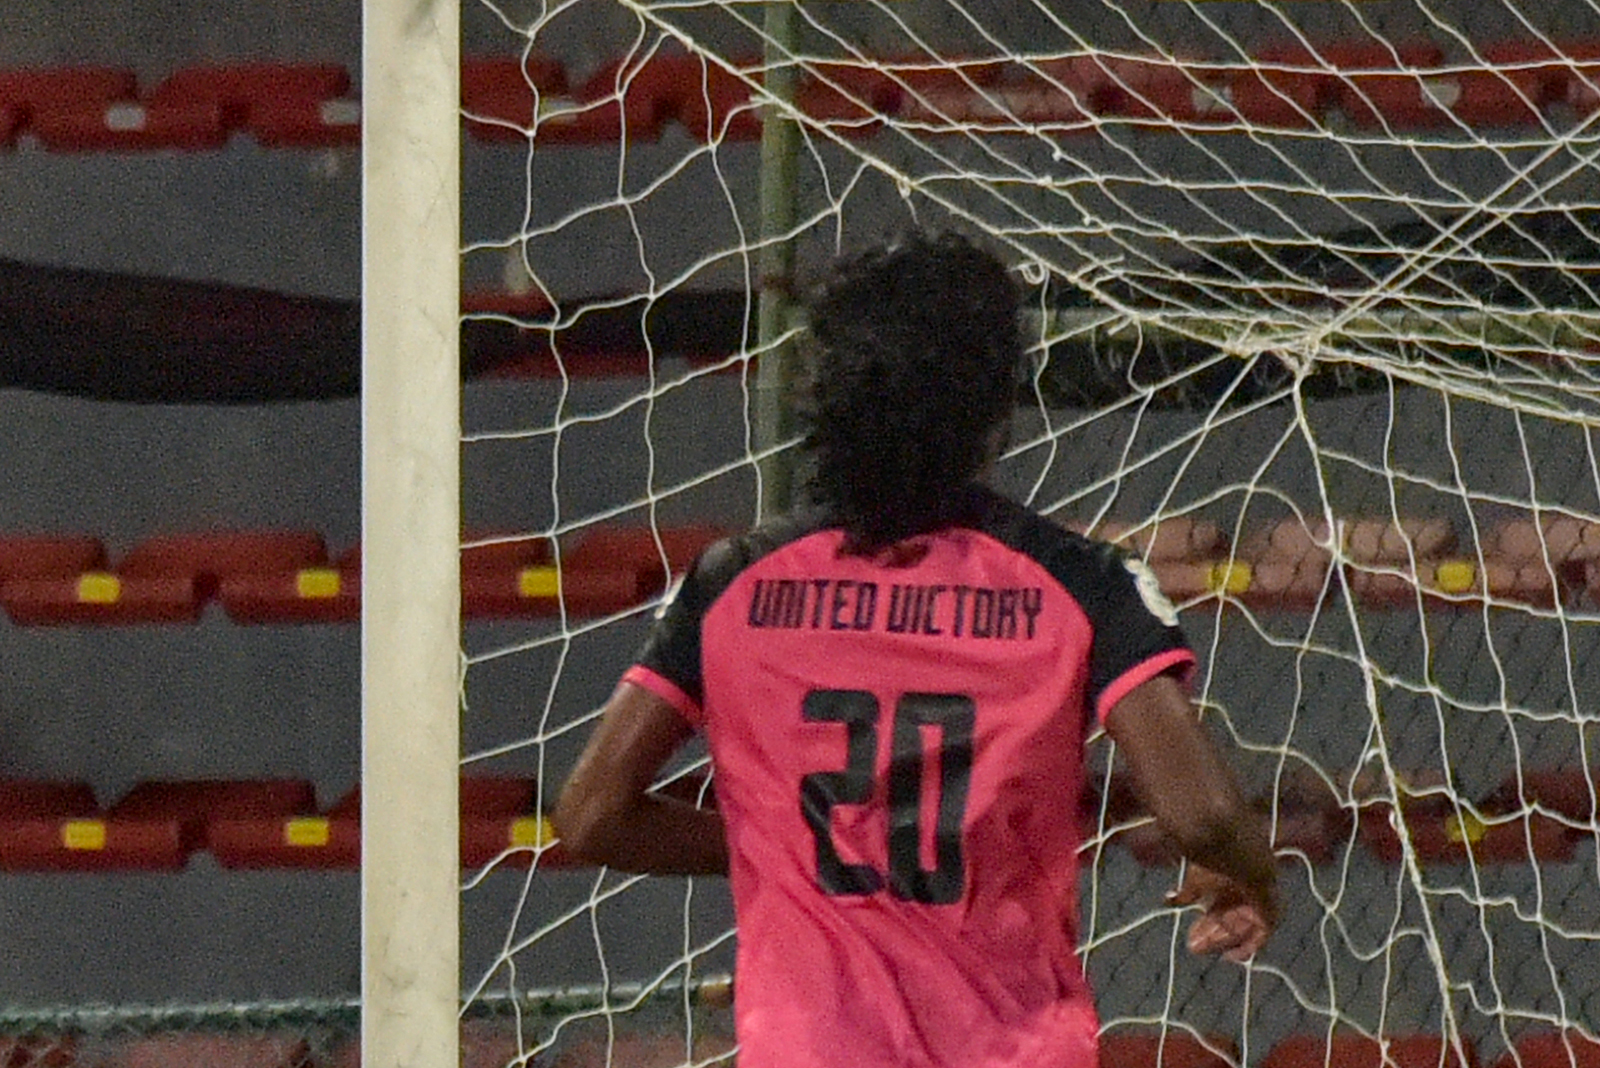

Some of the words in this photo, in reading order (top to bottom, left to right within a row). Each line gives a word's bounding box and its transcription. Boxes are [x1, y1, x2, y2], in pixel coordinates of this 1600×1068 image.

[748, 579, 878, 631] UNITED
[887, 585, 1042, 640] VICTORY
[800, 690, 977, 904] 20
